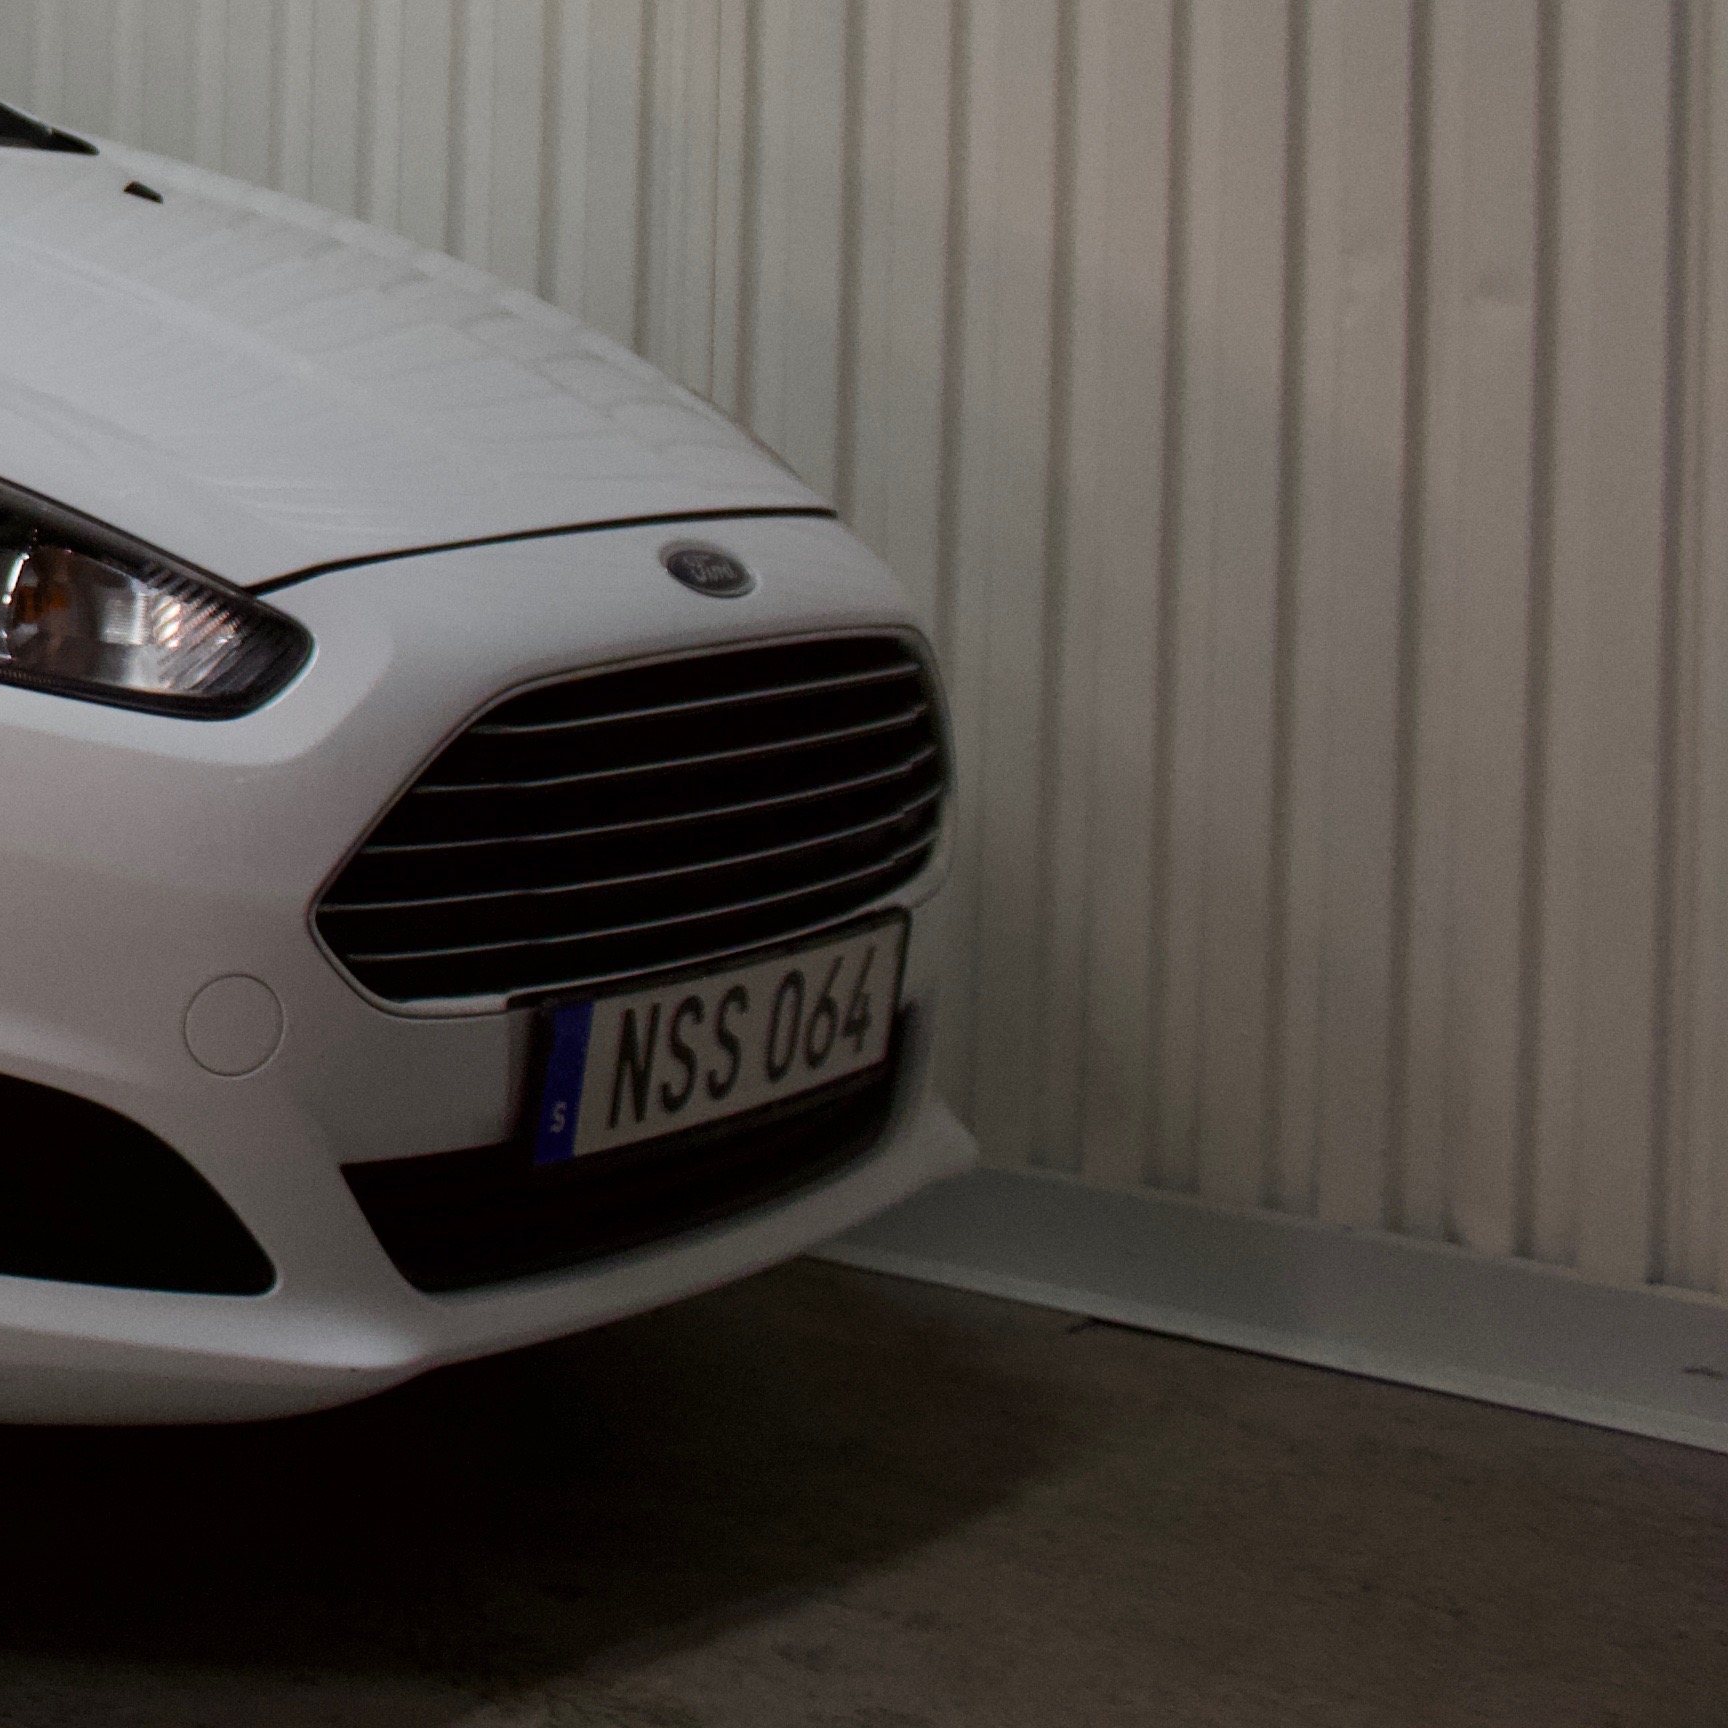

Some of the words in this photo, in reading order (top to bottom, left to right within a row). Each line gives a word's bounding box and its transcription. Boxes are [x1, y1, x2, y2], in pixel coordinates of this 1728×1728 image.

[607, 983, 750, 1130] NSS
[765, 944, 876, 1085] 064
[549, 1100, 567, 1134] S
